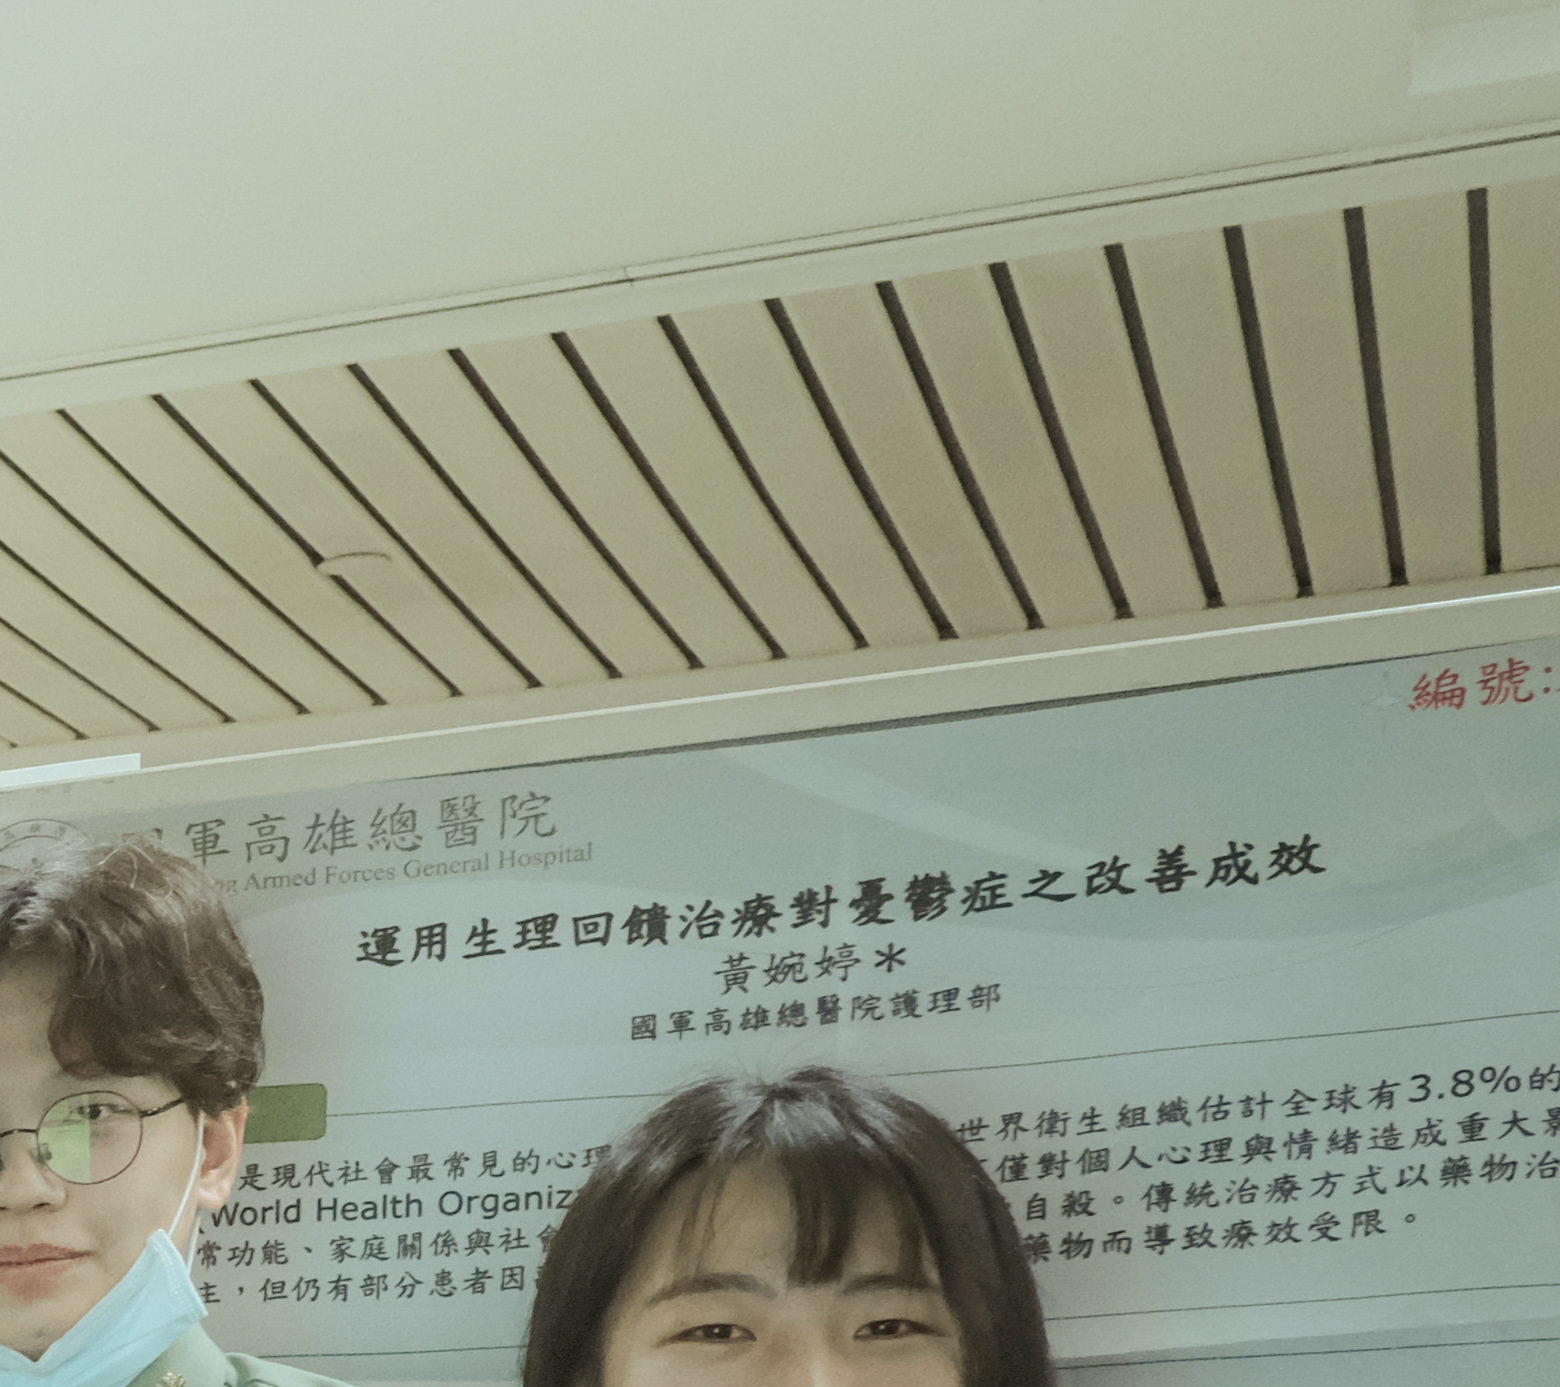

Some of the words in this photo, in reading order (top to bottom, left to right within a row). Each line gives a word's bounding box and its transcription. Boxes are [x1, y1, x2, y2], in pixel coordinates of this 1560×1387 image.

[123, 792, 557, 866] 軍高雄總醫院
[245, 868, 317, 891] Armed
[324, 862, 395, 886] Forces
[404, 853, 489, 878] General
[499, 842, 593, 870] Hospital
[354, 834, 1328, 968] 運用生理回饋治療對憂鬱症之改善成效
[631, 985, 1001, 1041] 國軍高雄總醫院護理部
[317, 1193, 423, 1223] Health
[438, 1184, 578, 1220] Organiz
[200, 1264, 542, 1305] 主，但仍有部分患者因
